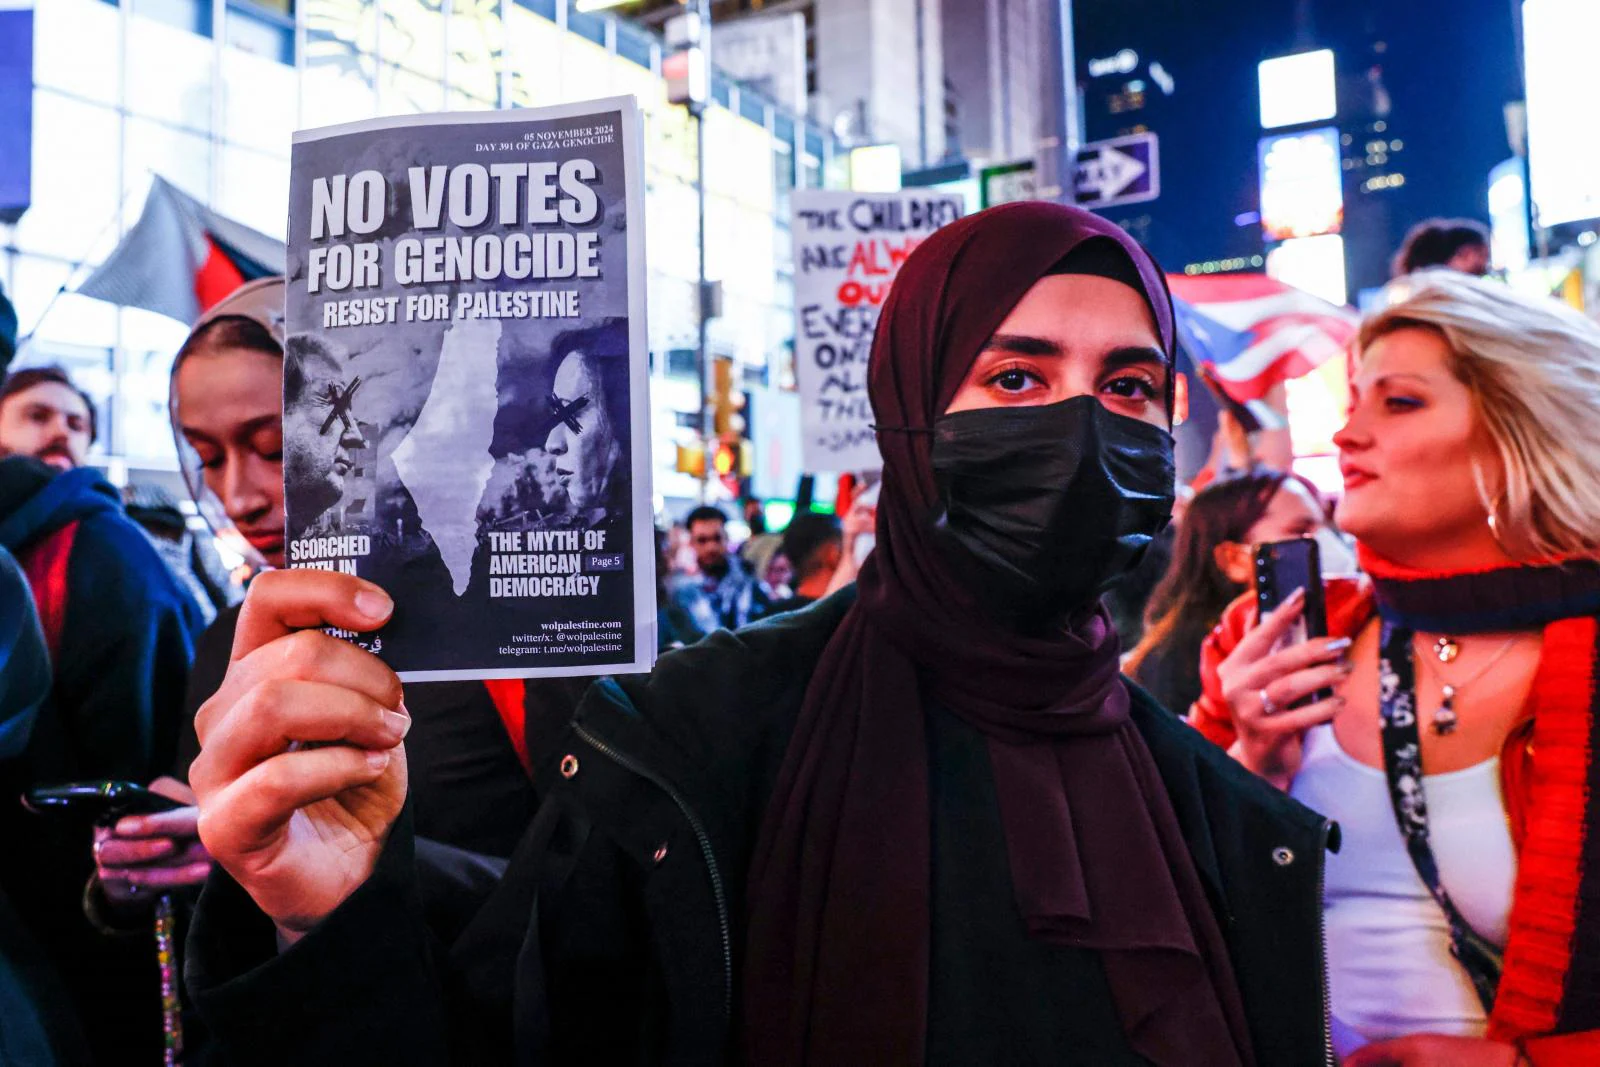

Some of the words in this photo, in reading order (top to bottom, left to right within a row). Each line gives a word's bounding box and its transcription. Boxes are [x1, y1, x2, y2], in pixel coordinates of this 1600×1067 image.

[524, 133, 535, 141] 05
[536, 127, 593, 140] NOVEMBER
[594, 124, 614, 135] 2024
[475, 143, 497, 152] DAY
[498, 141, 514, 151] 391
[516, 142, 531, 151] OF
[532, 140, 560, 150] GAZA
[562, 134, 614, 148] GENOCIDE
[310, 170, 386, 239] NO
[408, 159, 599, 229] VOTES
[307, 242, 380, 293] FOR
[394, 232, 599, 285] GENOCIDE
[323, 297, 399, 328] RESIST
[405, 293, 449, 321] FOR
[457, 290, 579, 318] PALESTINE
[290, 535, 371, 561] SCORCHED
[488, 531, 521, 552] THE
[527, 530, 579, 551] MYTH
[584, 530, 606, 550] OF
[339, 559, 357, 577] IN
[489, 553, 581, 575] AMERICAN
[592, 557, 613, 568] Page
[614, 556, 620, 565] 5
[489, 576, 600, 597] DEMOCRACY
[541, 621, 622, 632] wolpalestine.com
[512, 634, 553, 642] twitter/x:
[556, 632, 622, 642] @wolpalestine
[499, 646, 541, 656] telegram:
[544, 643, 622, 654] t.me/wolpalestine
